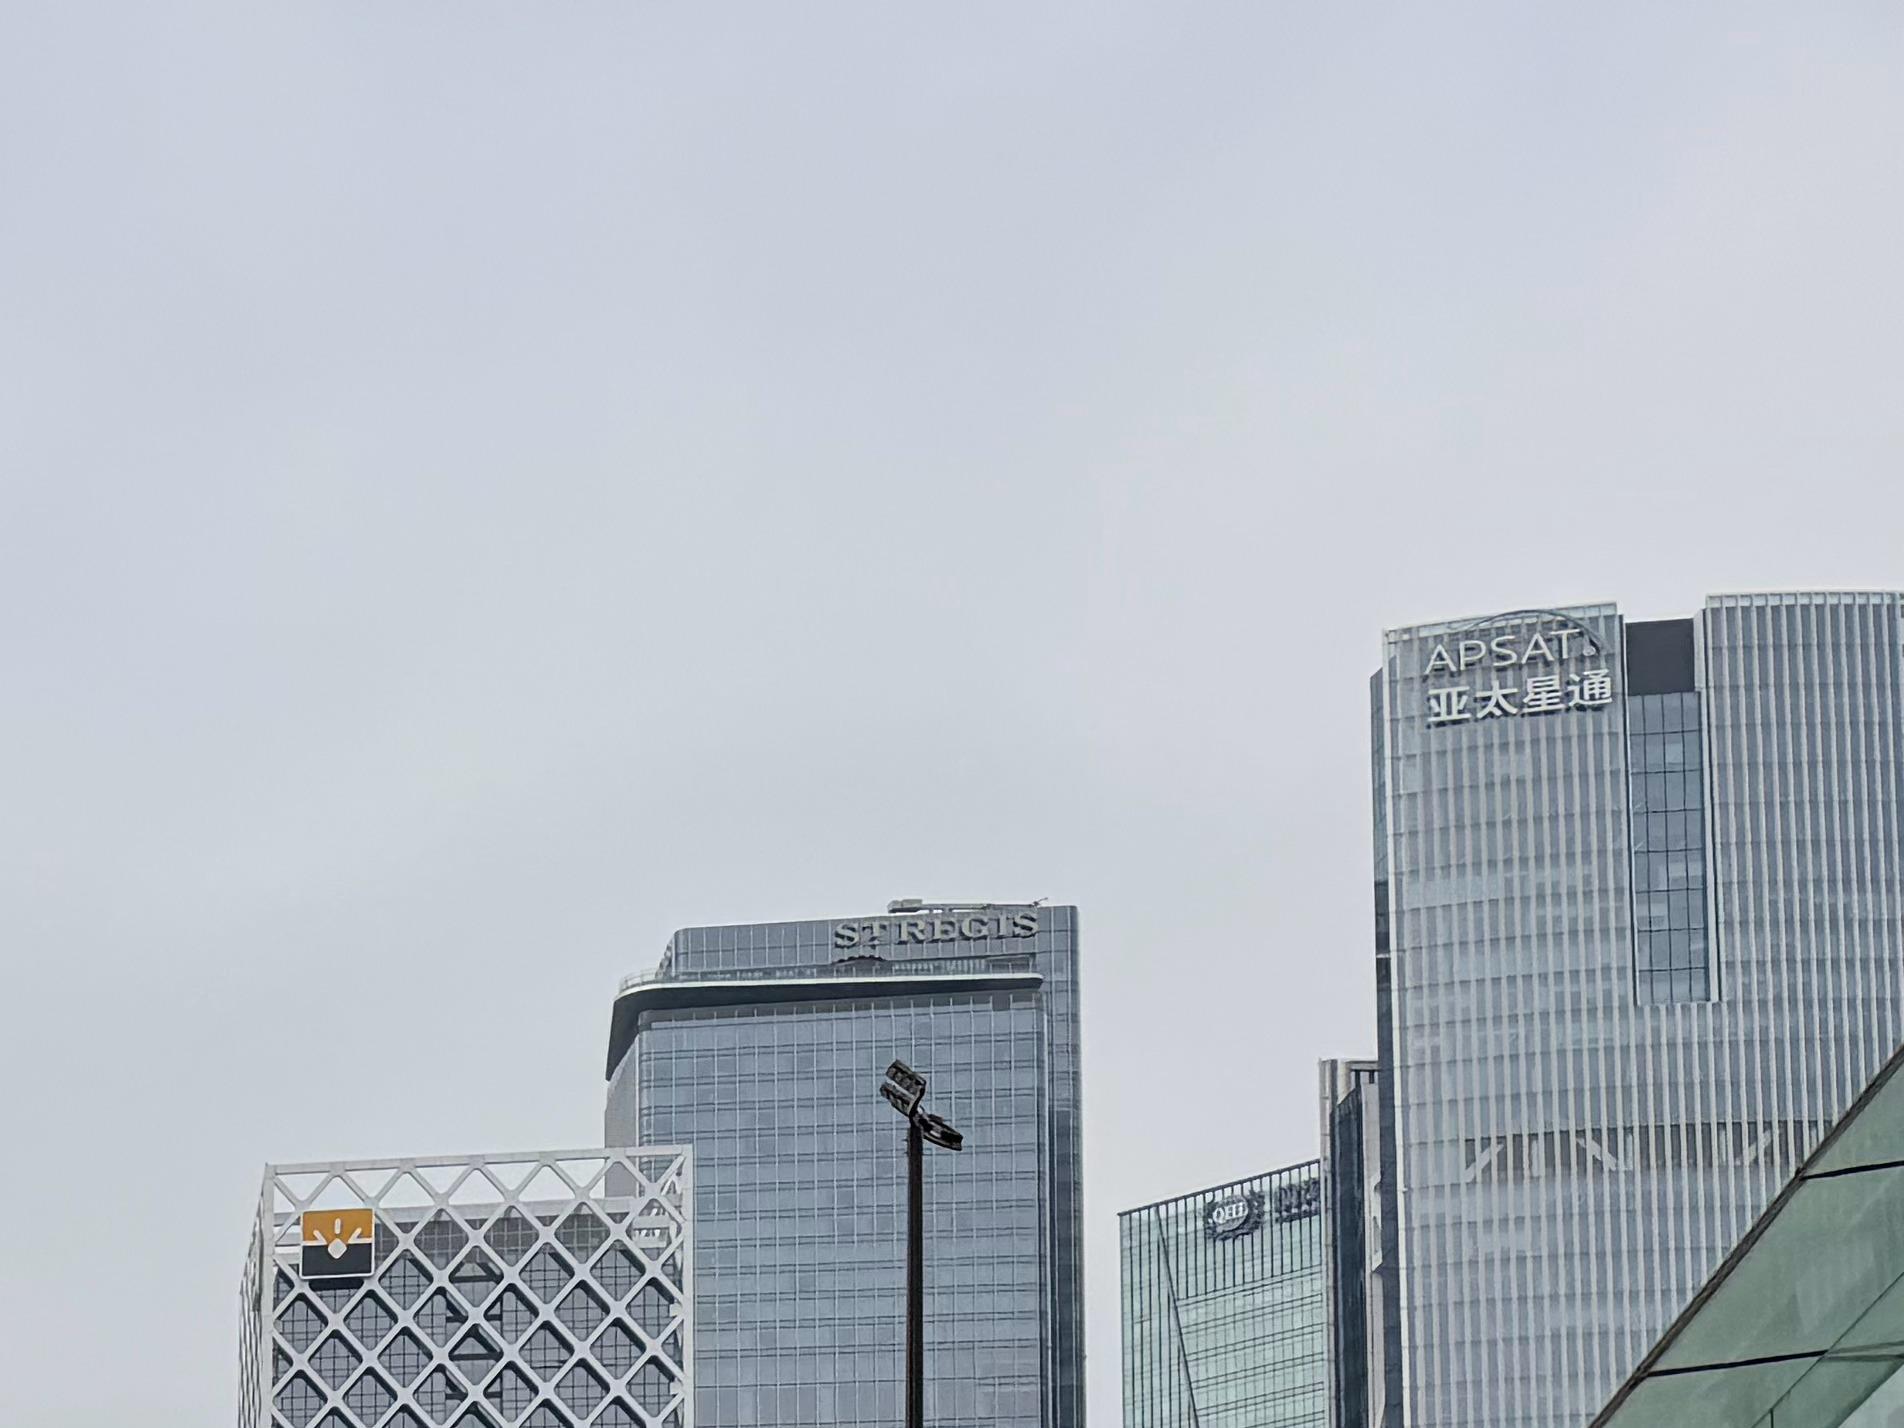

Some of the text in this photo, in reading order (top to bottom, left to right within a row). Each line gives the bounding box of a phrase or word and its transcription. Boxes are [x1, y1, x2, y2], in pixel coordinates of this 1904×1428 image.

[1423, 627, 1582, 676] APSAT
[1426, 669, 1614, 726] 亚太星通
[898, 911, 1040, 945] REGIS
